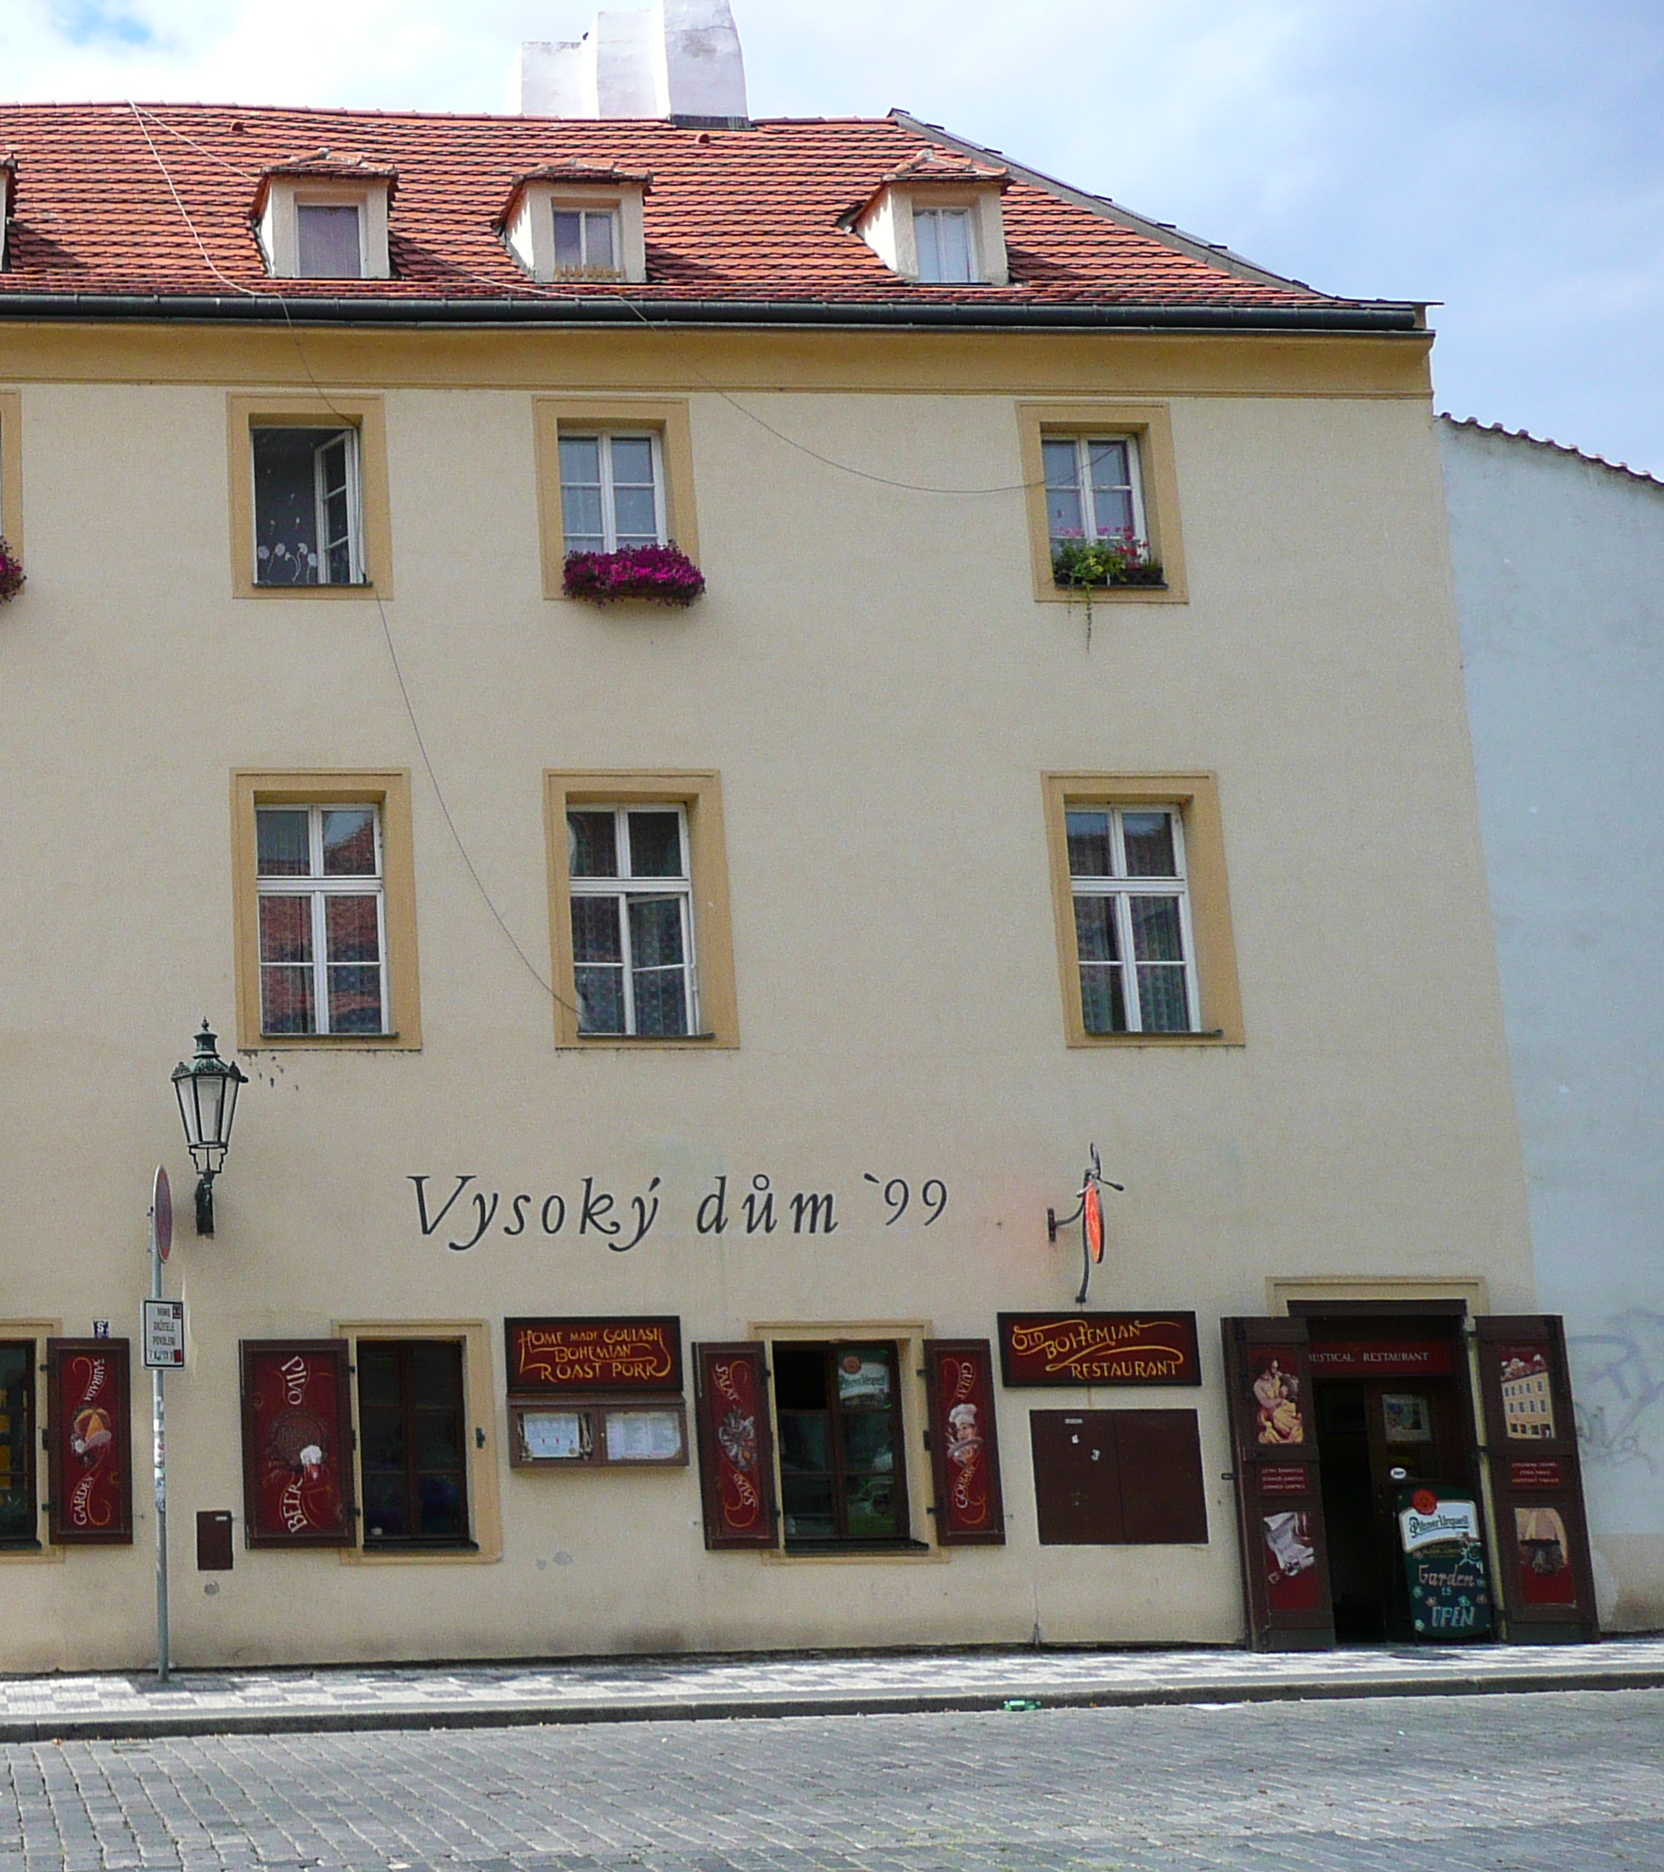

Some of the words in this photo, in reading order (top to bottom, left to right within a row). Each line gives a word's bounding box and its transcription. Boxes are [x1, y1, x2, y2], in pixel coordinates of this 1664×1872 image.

[407, 1175, 661, 1252] Vysoký
[697, 1173, 838, 1235] dům
[519, 1330, 563, 1350] HOME
[570, 1331, 599, 1342] MADE
[603, 1328, 664, 1346] GOULASH
[1012, 1331, 1044, 1350] OLD
[1045, 1324, 1141, 1360] BOHEMIAN
[555, 1344, 632, 1363] BOHEMIAN
[1363, 1352, 1429, 1362] RESTAURANT
[281, 1356, 307, 1405] PIVO
[541, 1362, 602, 1382] ROAST
[612, 1362, 660, 1379] PORK
[1070, 1361, 1179, 1379] RESTAURANT
[74, 1476, 94, 1525] GARDEN
[283, 1477, 307, 1533] BEER
[1419, 1564, 1475, 1587] Garden
[1432, 1606, 1475, 1628] OPEN
